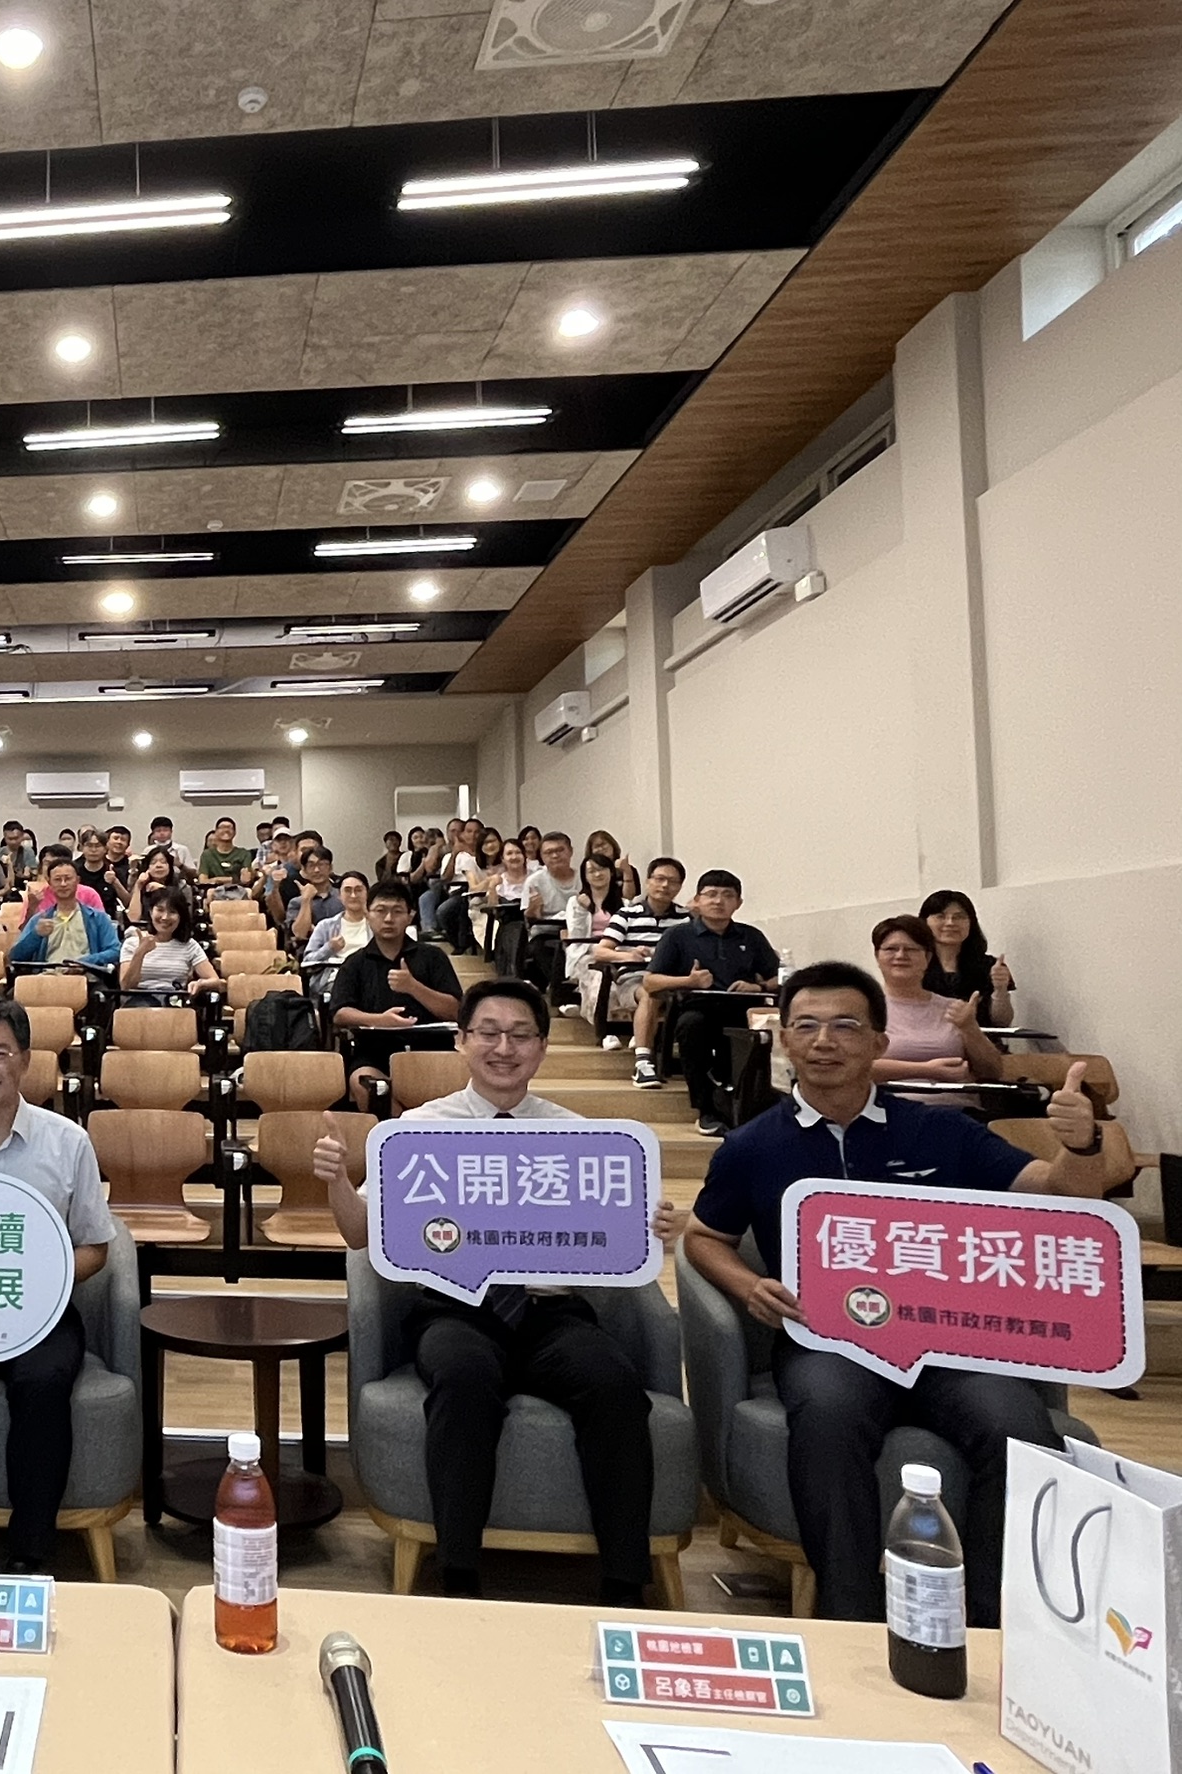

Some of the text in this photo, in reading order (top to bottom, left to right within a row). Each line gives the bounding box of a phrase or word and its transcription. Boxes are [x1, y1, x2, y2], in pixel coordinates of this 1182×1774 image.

[397, 1153, 634, 1208] 公開透明
[466, 1230, 608, 1248] 桃園市政府教育局
[816, 1213, 1106, 1298] 優質採購
[896, 1303, 1073, 1341] 桃園市政府教育局
[1006, 1695, 1093, 1770] TAOYUAN
